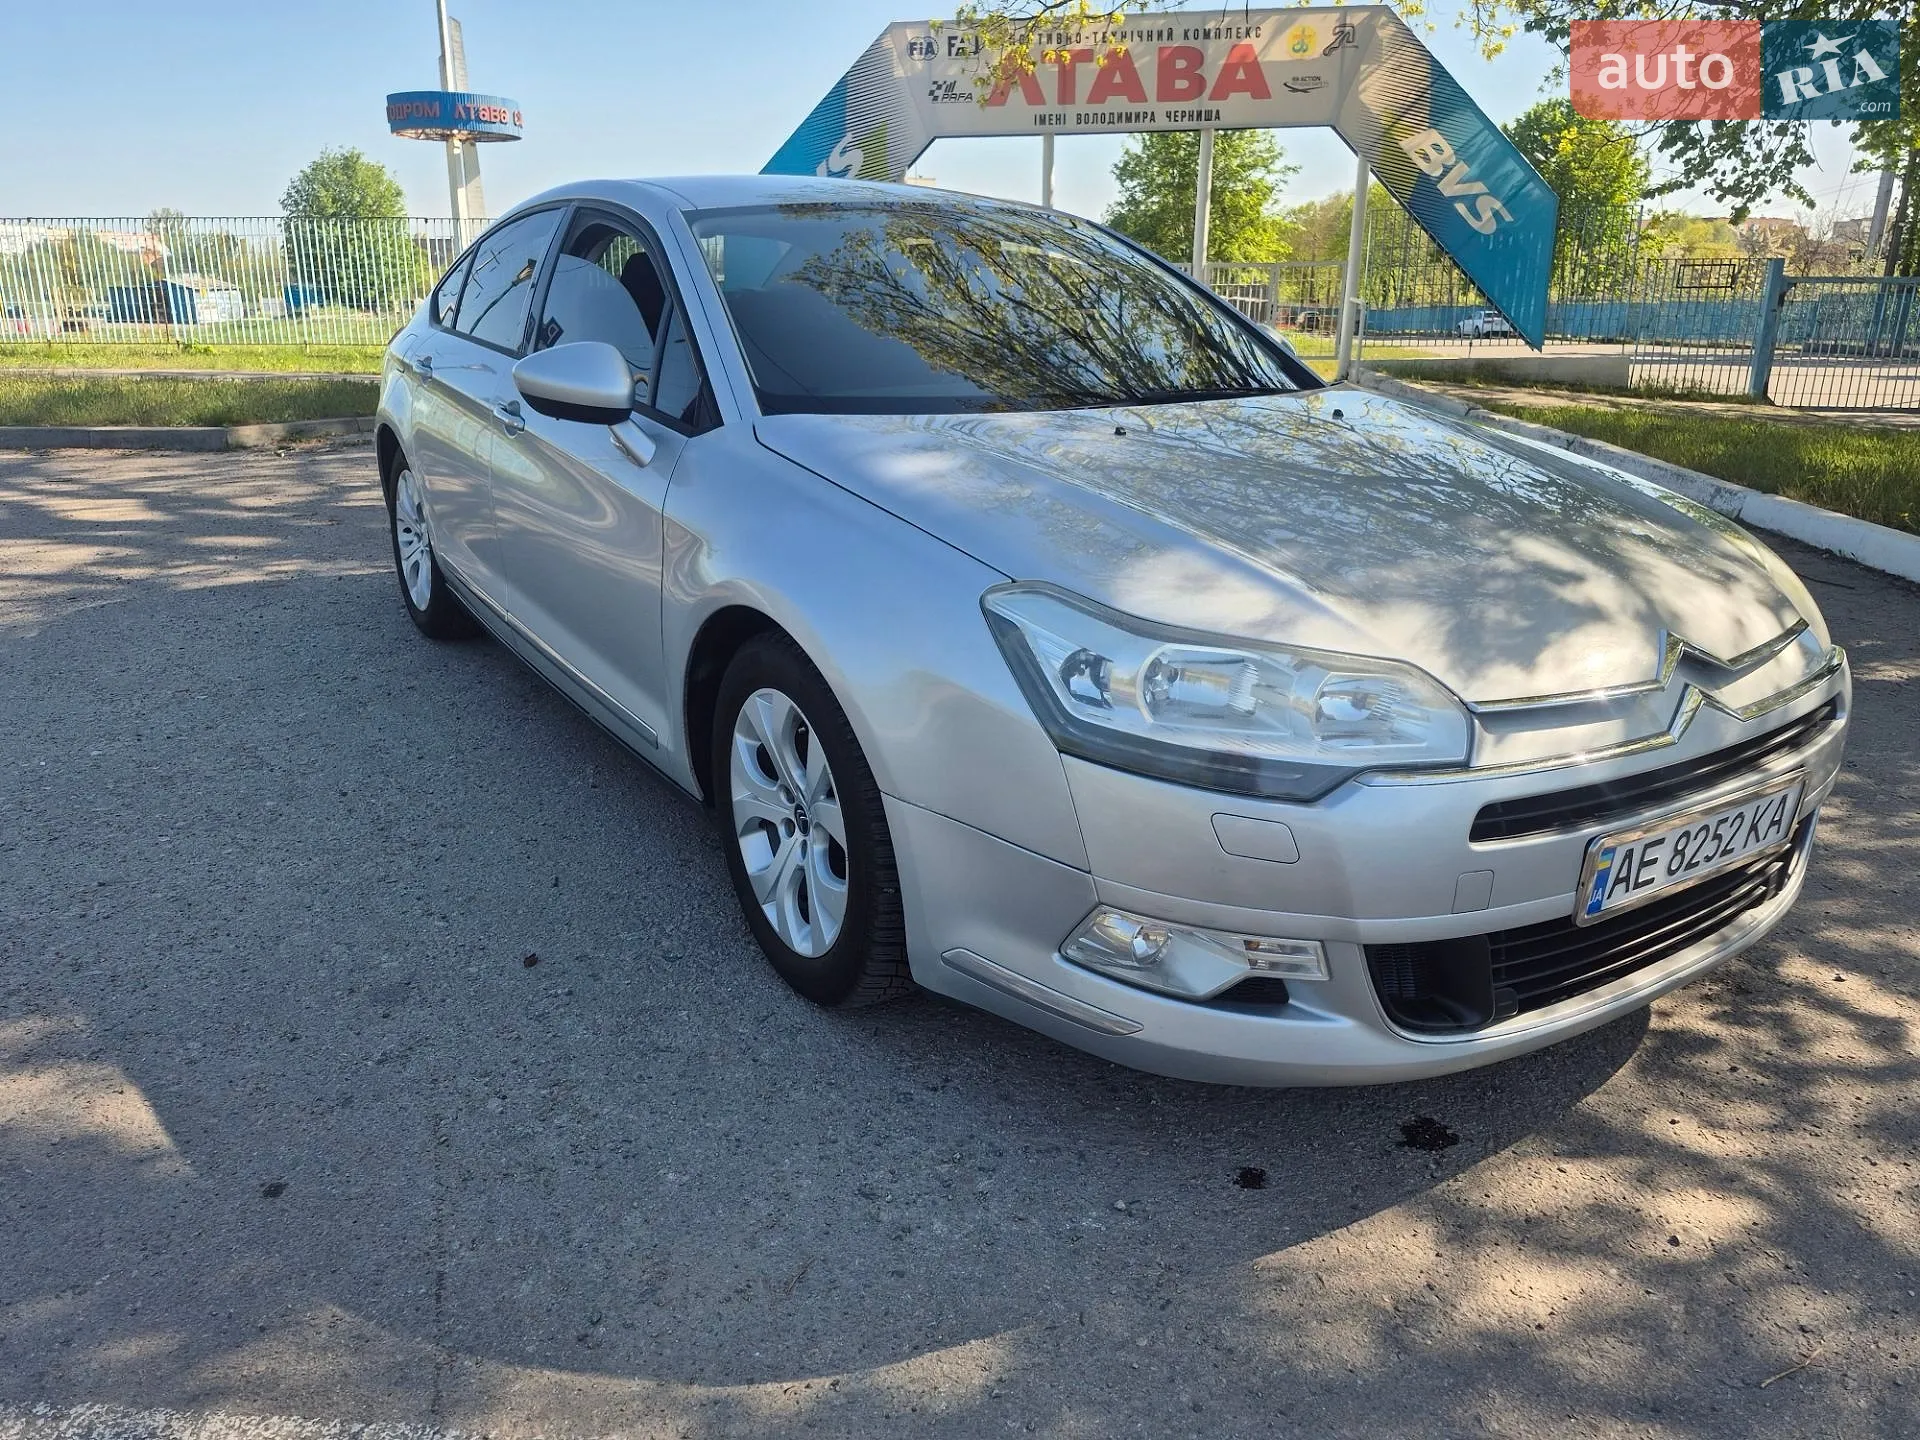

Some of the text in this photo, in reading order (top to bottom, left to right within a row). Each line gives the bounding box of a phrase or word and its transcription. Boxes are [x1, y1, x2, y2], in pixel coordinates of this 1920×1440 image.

[1183, 26, 1262, 40] КОМПЛЕКС
[387, 101, 440, 121] ОДРОМ
[1034, 109, 1221, 126] ІМЕНІ ВОЛОДИМИРА ЧЕРНИША
[1400, 128, 1514, 235] BVS
[1607, 793, 1788, 900] AE 8252 KA
